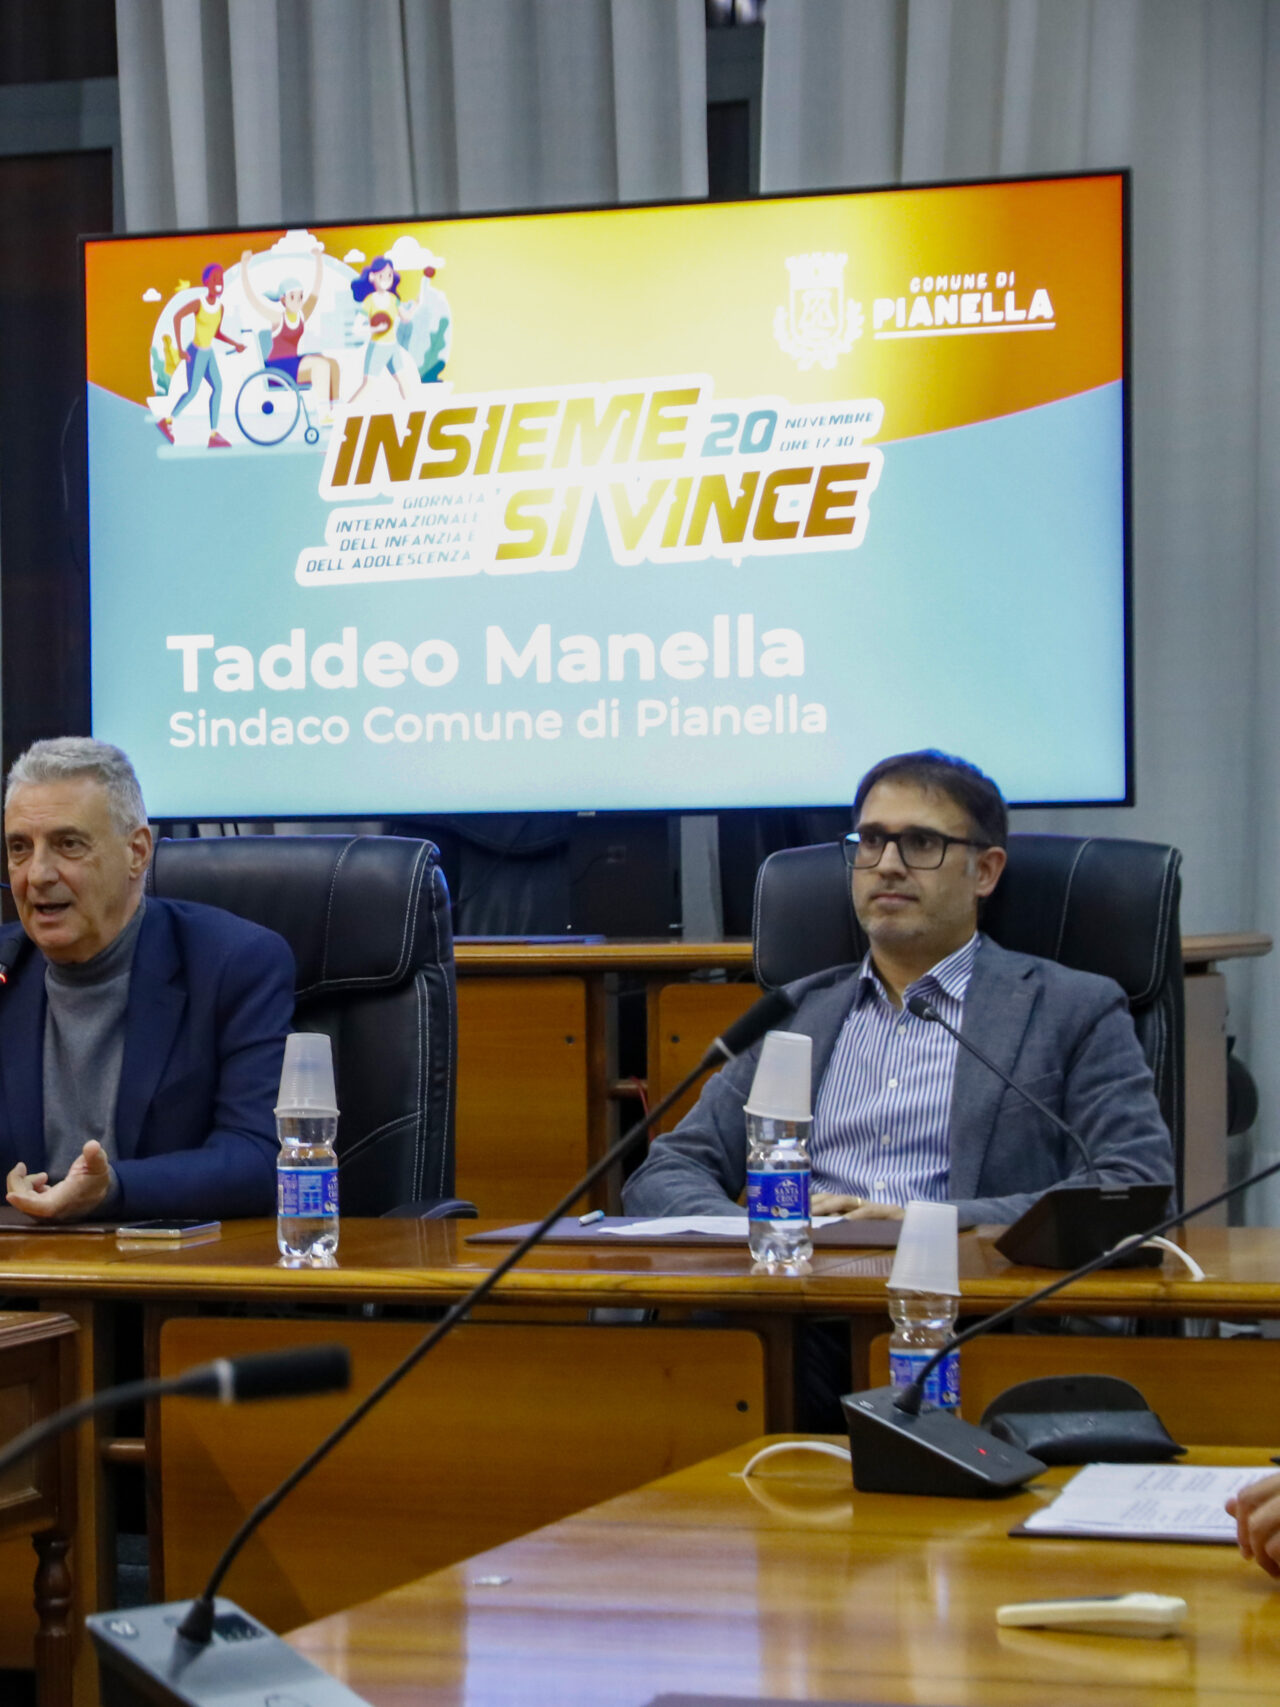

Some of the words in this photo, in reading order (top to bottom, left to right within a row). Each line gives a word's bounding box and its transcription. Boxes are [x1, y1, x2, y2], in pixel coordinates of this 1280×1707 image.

[909, 272, 988, 293] COMUNE
[995, 270, 1015, 289] DI
[873, 288, 1054, 330] PIANELLA
[785, 412, 873, 429] NOVEMBRE
[330, 387, 701, 487] INSIEME
[700, 409, 778, 457] 20
[780, 439, 808, 452] ORE
[402, 492, 485, 510] GIORNATA
[495, 486, 584, 561] SI
[609, 462, 871, 552] VINCE
[336, 512, 478, 533] INTERNAZIONALE
[384, 532, 461, 549] INFANZIA
[351, 549, 471, 570] ADOLESCENZA
[166, 626, 460, 692] Taddeo
[485, 613, 806, 686] Manella
[168, 707, 350, 749] Sindaco
[363, 706, 563, 745] Comune
[577, 698, 620, 739] di
[637, 693, 828, 738] Pianella
